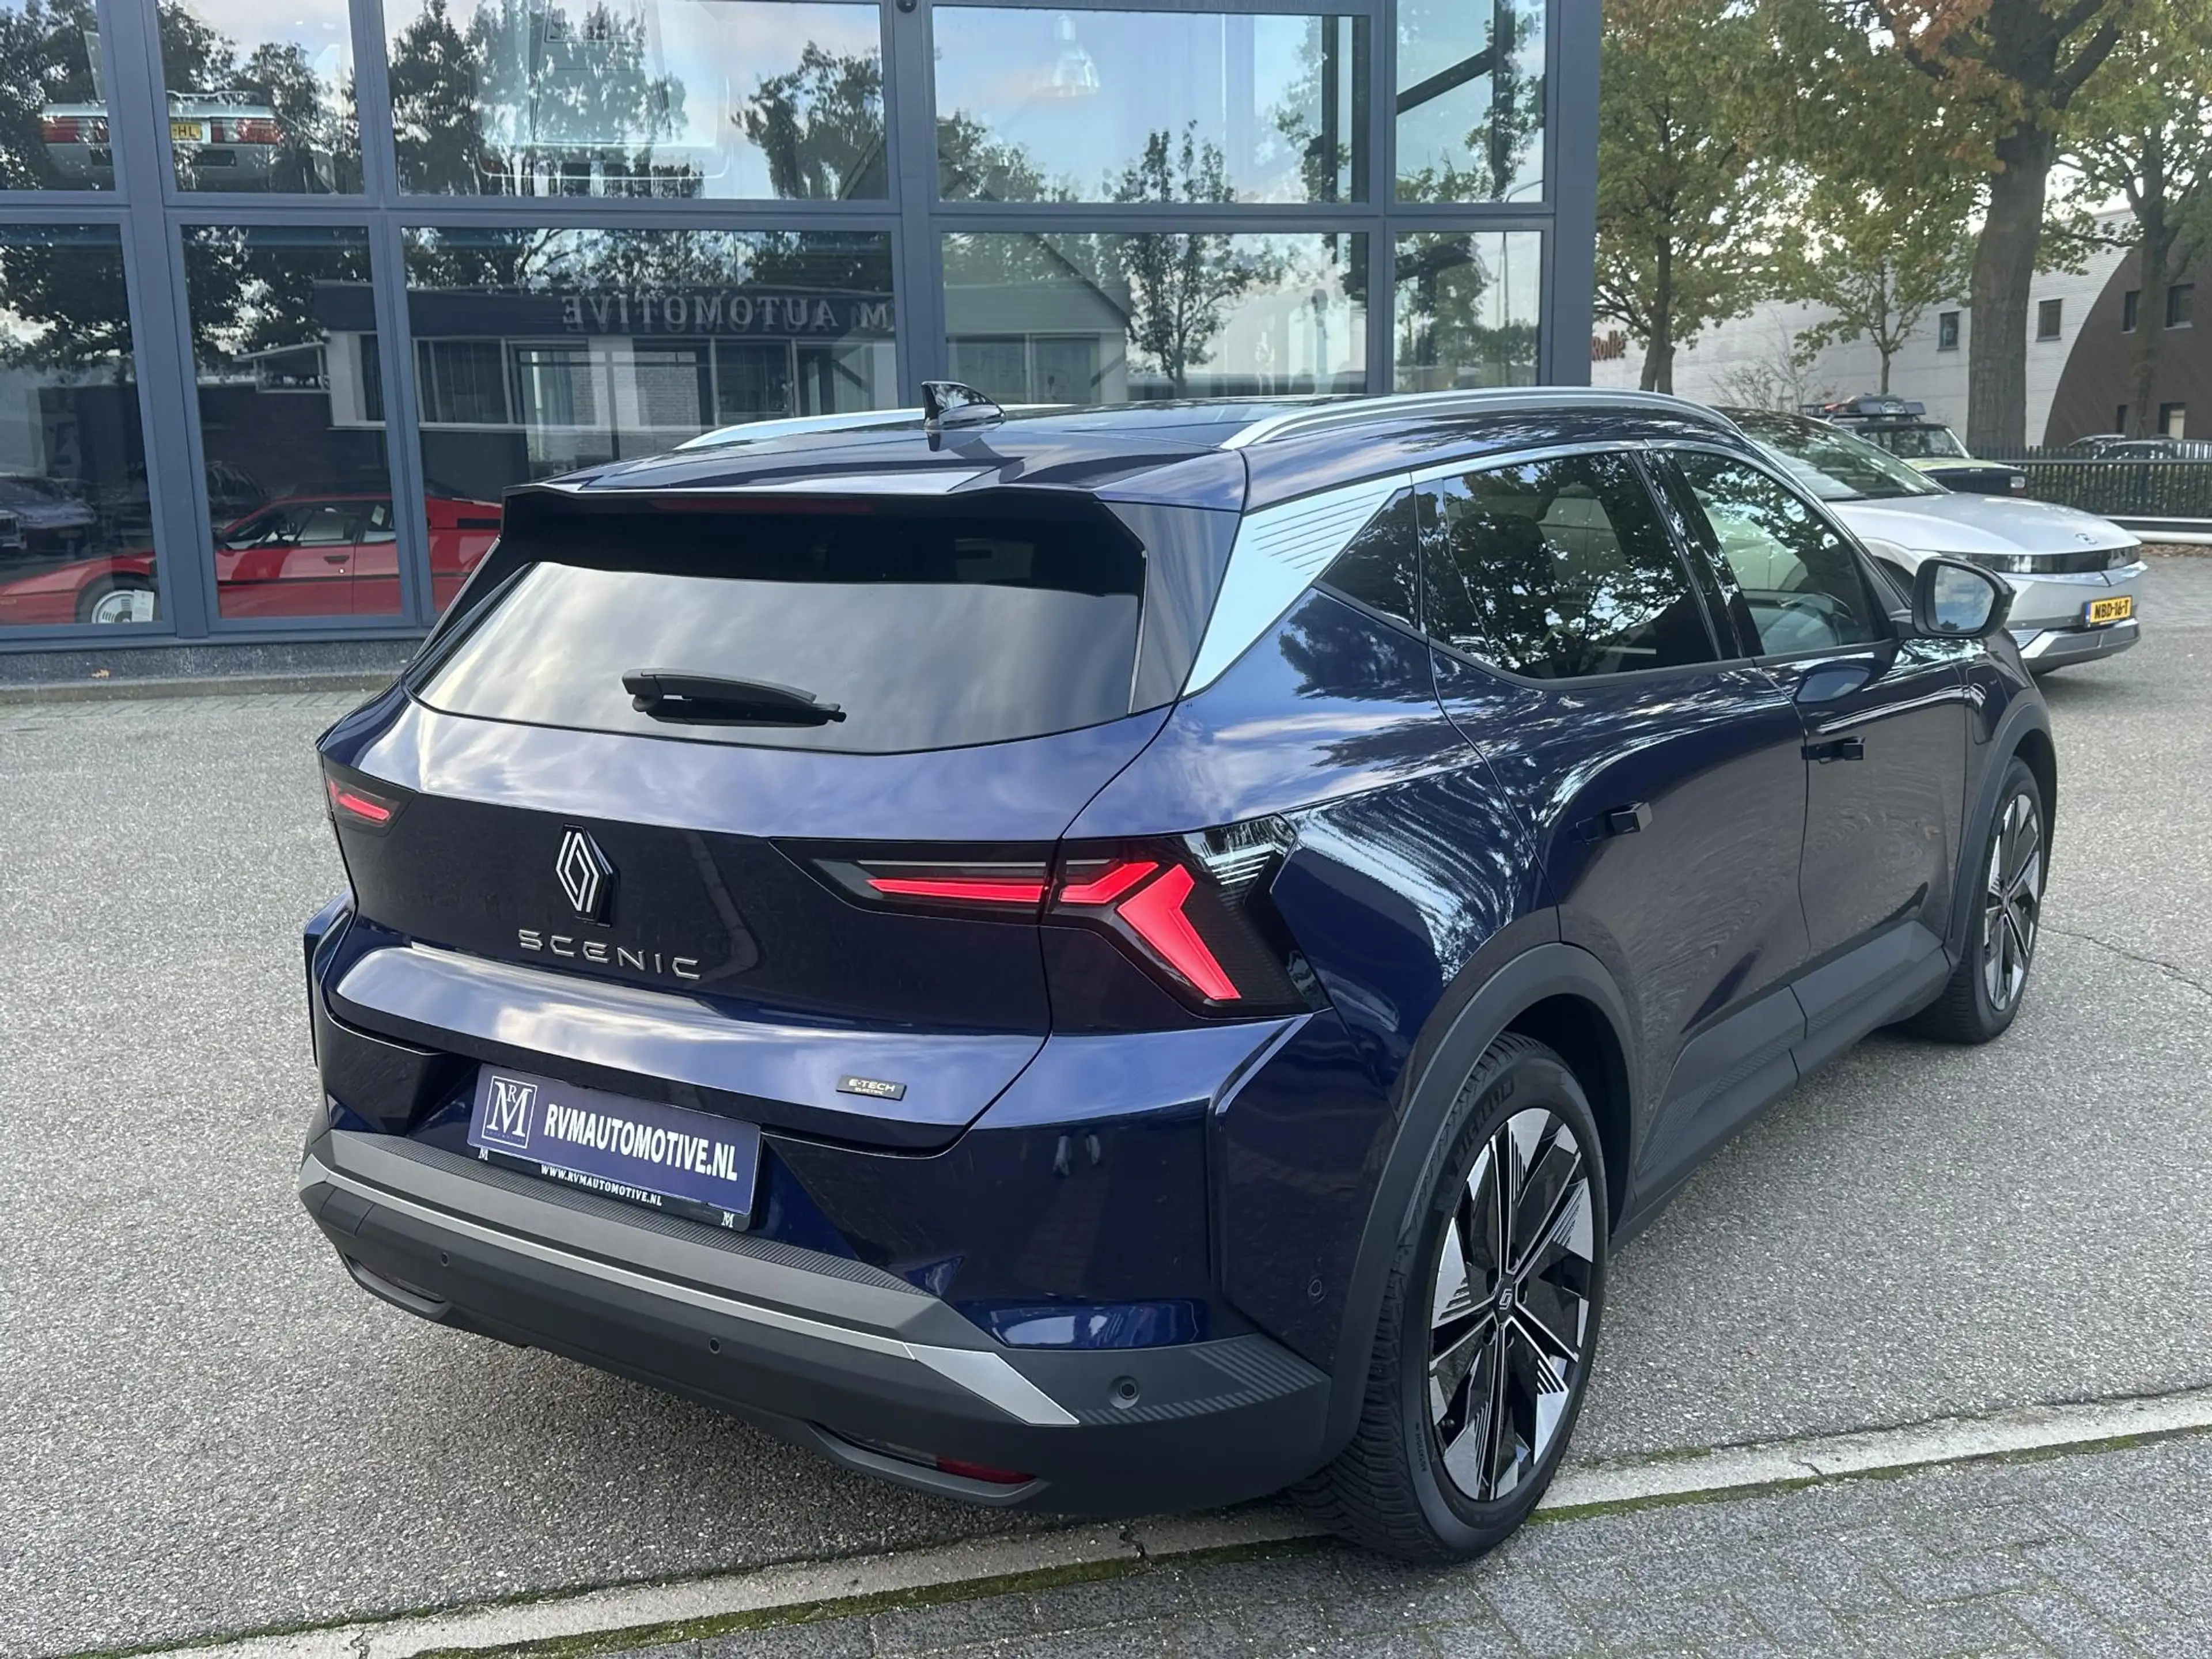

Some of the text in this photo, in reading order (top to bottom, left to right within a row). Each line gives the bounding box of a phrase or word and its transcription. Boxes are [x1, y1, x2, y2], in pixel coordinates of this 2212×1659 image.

[518, 929, 700, 979] SCENIC
[849, 1078, 896, 1092] E-TECH
[544, 1104, 738, 1181] RVMAUTOMOTIVE.NL
[540, 1164, 662, 1206] WWW.RVMAUTOMOTIVE.NL
